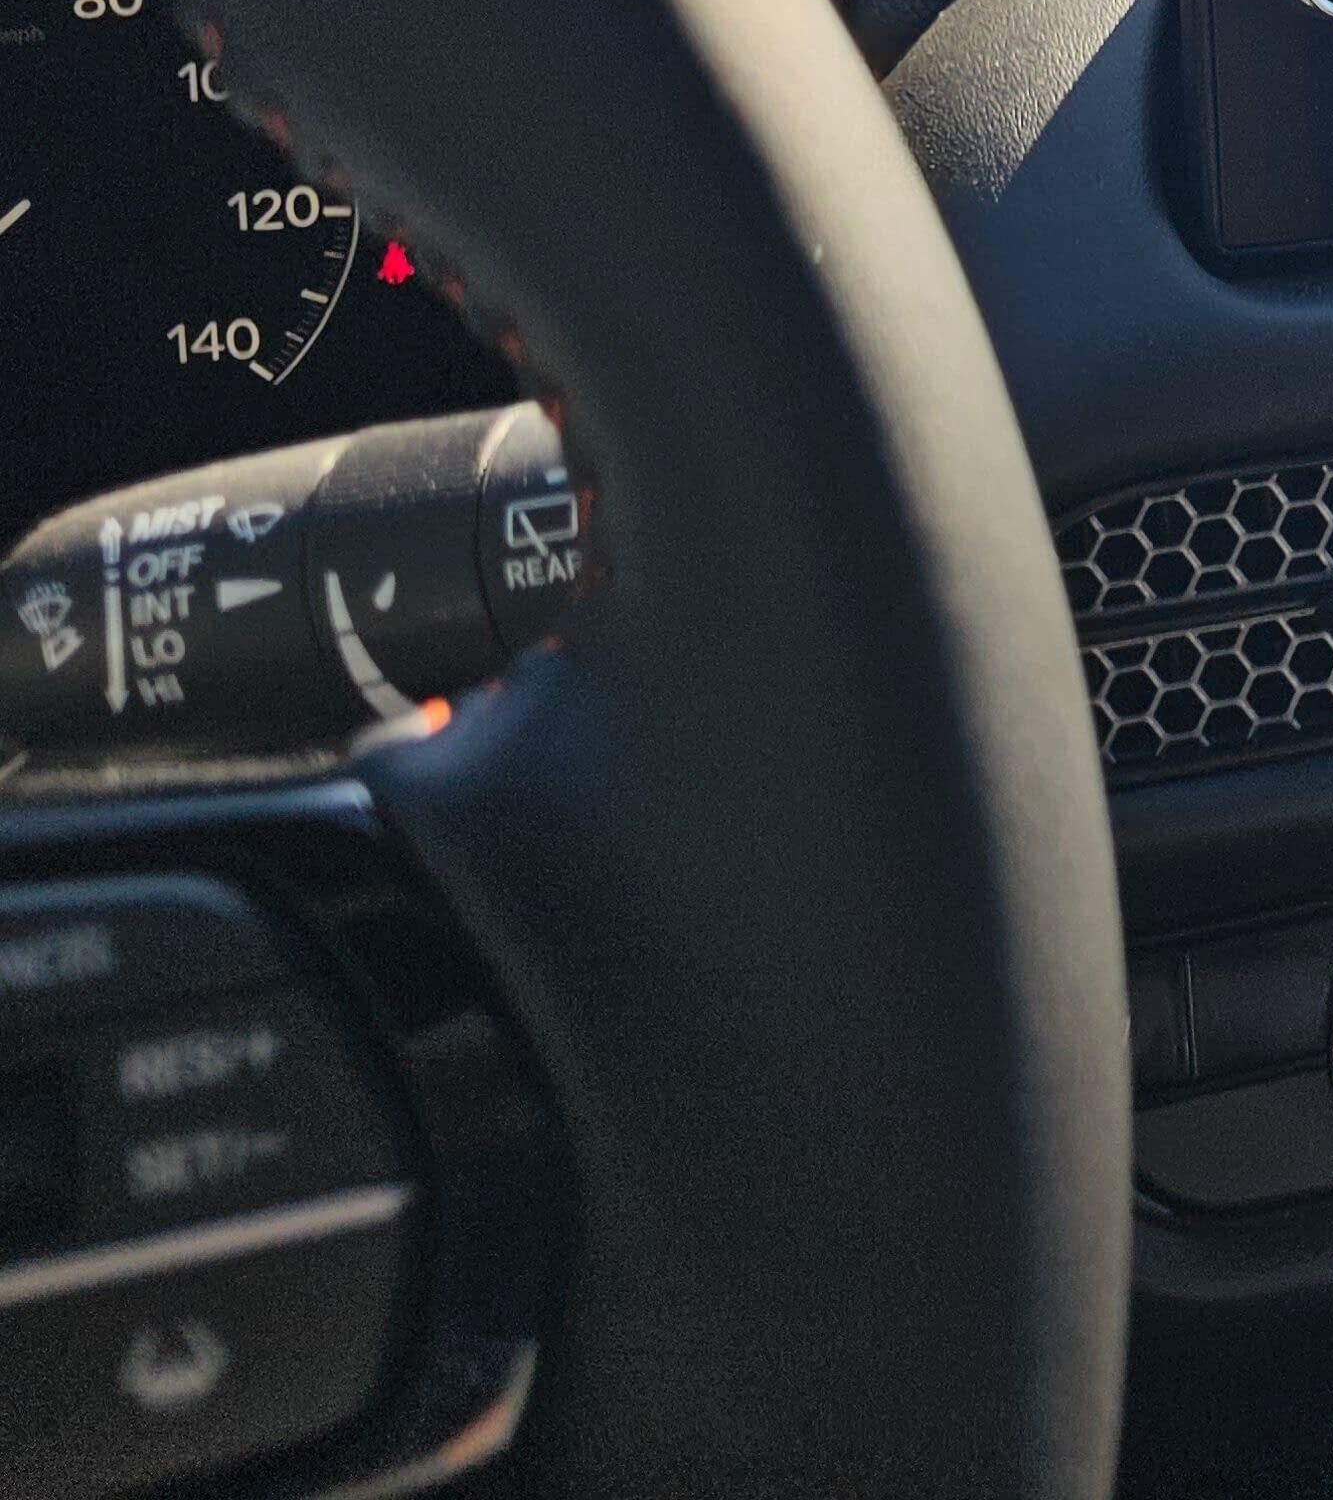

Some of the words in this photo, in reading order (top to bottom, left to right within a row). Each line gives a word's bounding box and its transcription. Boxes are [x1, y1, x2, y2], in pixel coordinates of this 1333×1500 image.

[178, 60, 232, 102] 10
[227, 185, 320, 231] 120
[167, 317, 260, 364] 140
[127, 543, 205, 586] OFF
[130, 585, 195, 626] INT
[130, 629, 186, 668] LO
